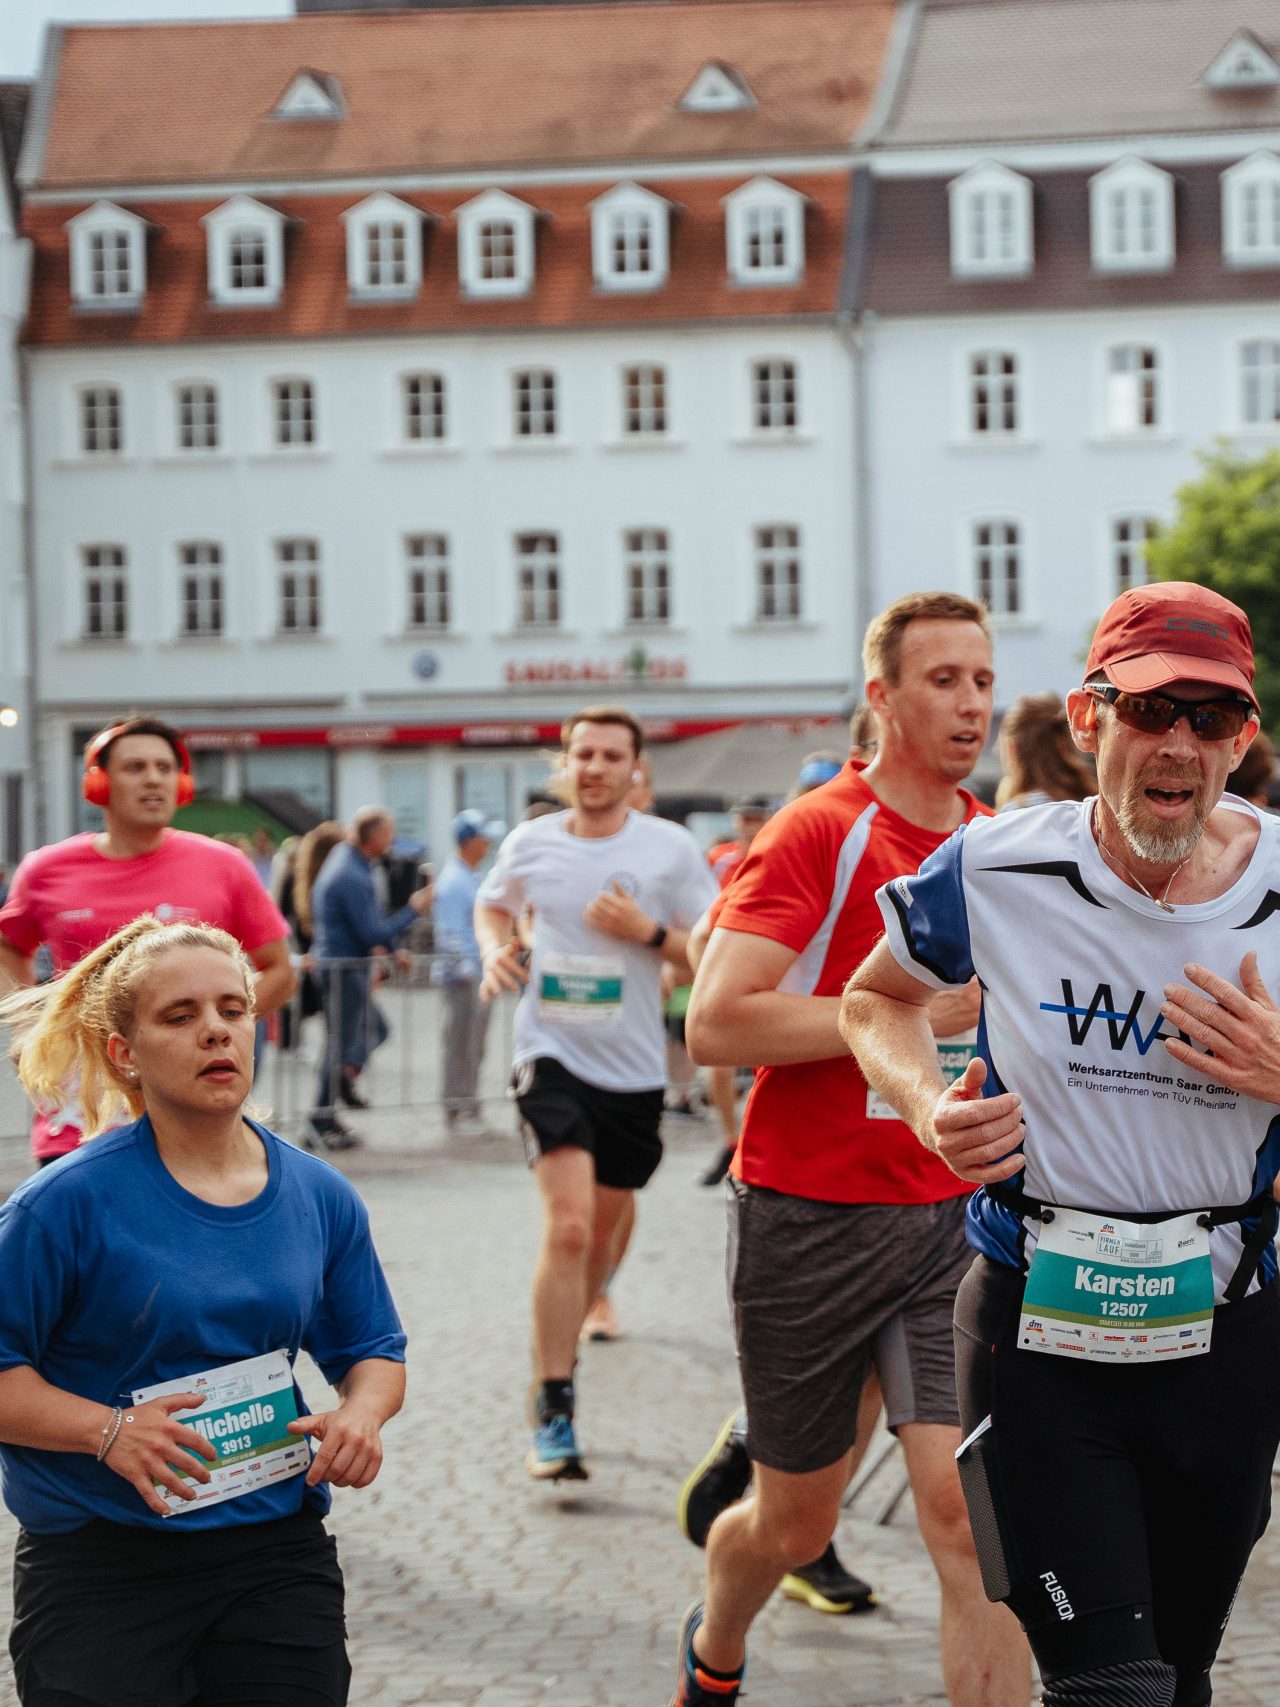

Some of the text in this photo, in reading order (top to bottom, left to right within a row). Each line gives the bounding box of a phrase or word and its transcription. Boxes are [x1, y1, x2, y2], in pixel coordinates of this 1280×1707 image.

[1068, 1061, 1173, 1086] Werksarztzentrum
[1176, 1078, 1203, 1092] Saar
[1067, 1077, 1236, 1110] Ein Unternehmen von TÜV Rheinland
[1098, 1244, 1120, 1256] LAUF
[1074, 1264, 1175, 1297] Karsten
[1100, 1301, 1148, 1317] 12507
[1028, 1319, 1043, 1328] dm
[184, 1403, 275, 1441] Michelle
[221, 1435, 252, 1455] 3913
